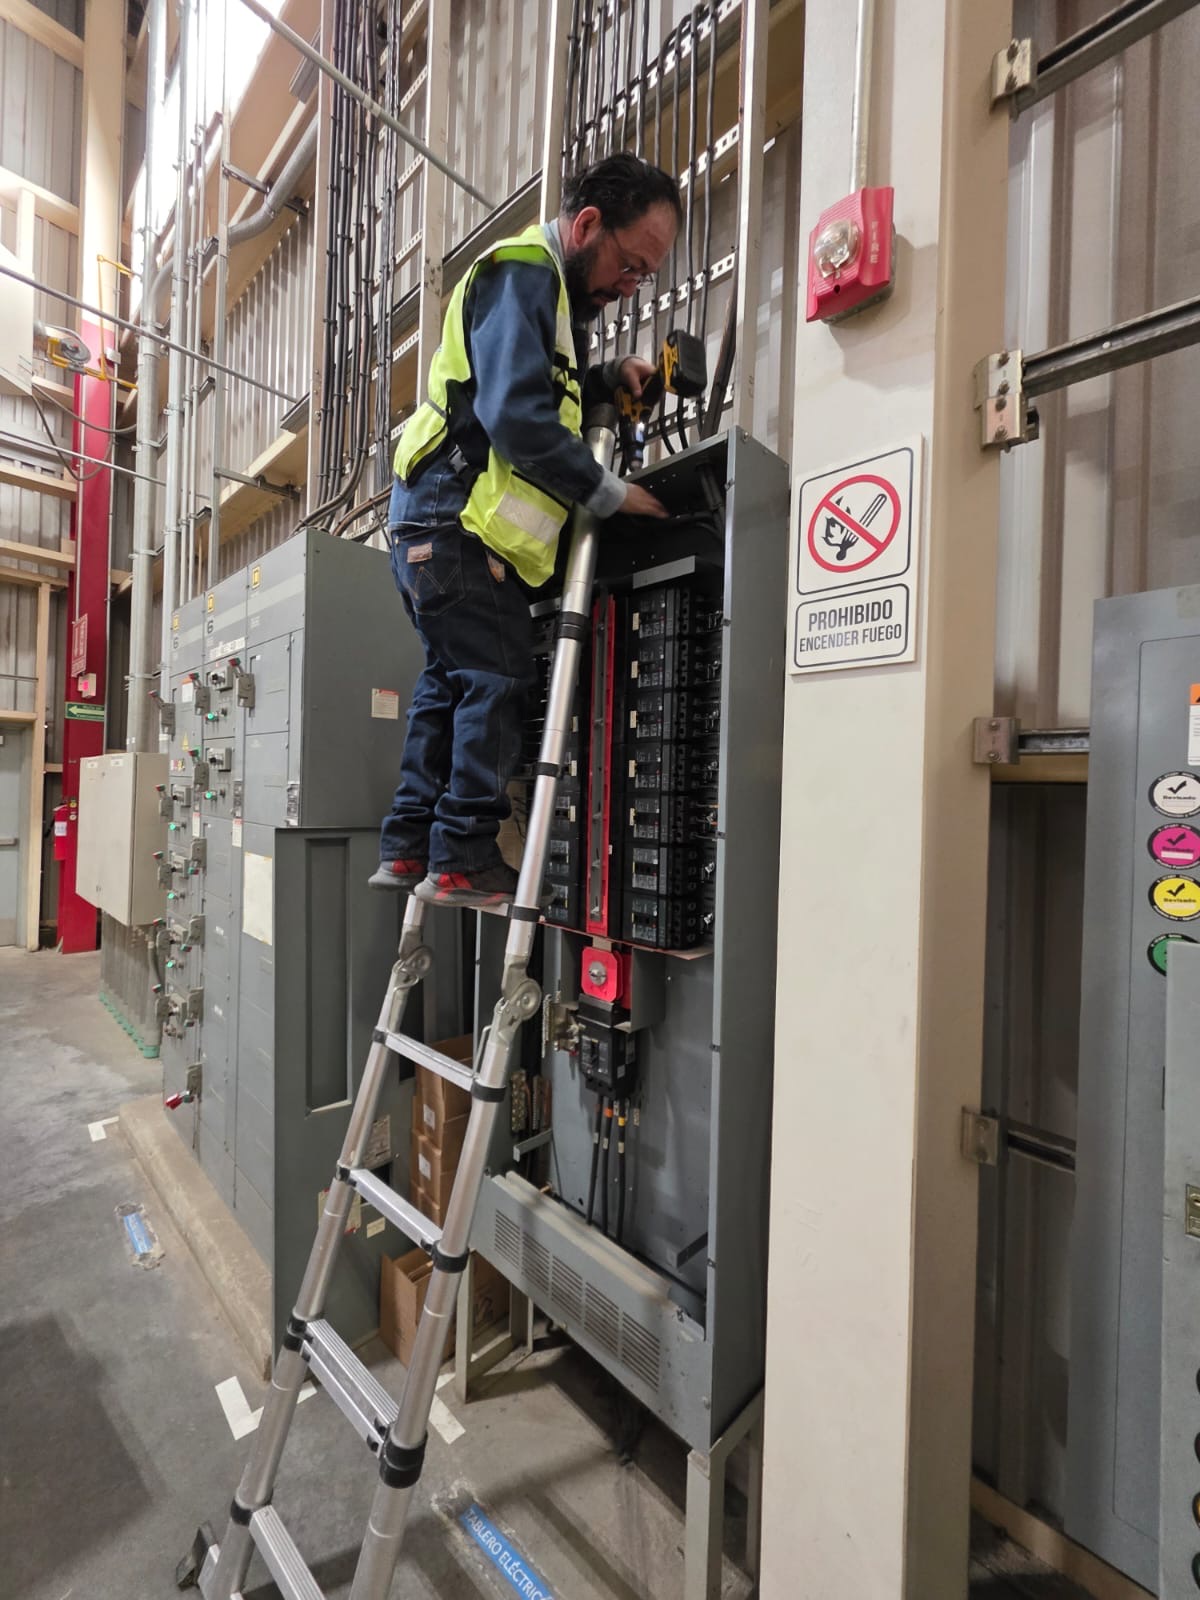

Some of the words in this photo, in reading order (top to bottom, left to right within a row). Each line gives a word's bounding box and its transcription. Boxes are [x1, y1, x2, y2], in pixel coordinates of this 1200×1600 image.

[870, 221, 880, 264] FIRE
[206, 620, 214, 634] 6
[808, 599, 893, 632] PROHIBIDO
[799, 630, 859, 653] ENCENDER
[862, 623, 902, 644] FUEGO
[464, 1509, 503, 1556] TABLERO
